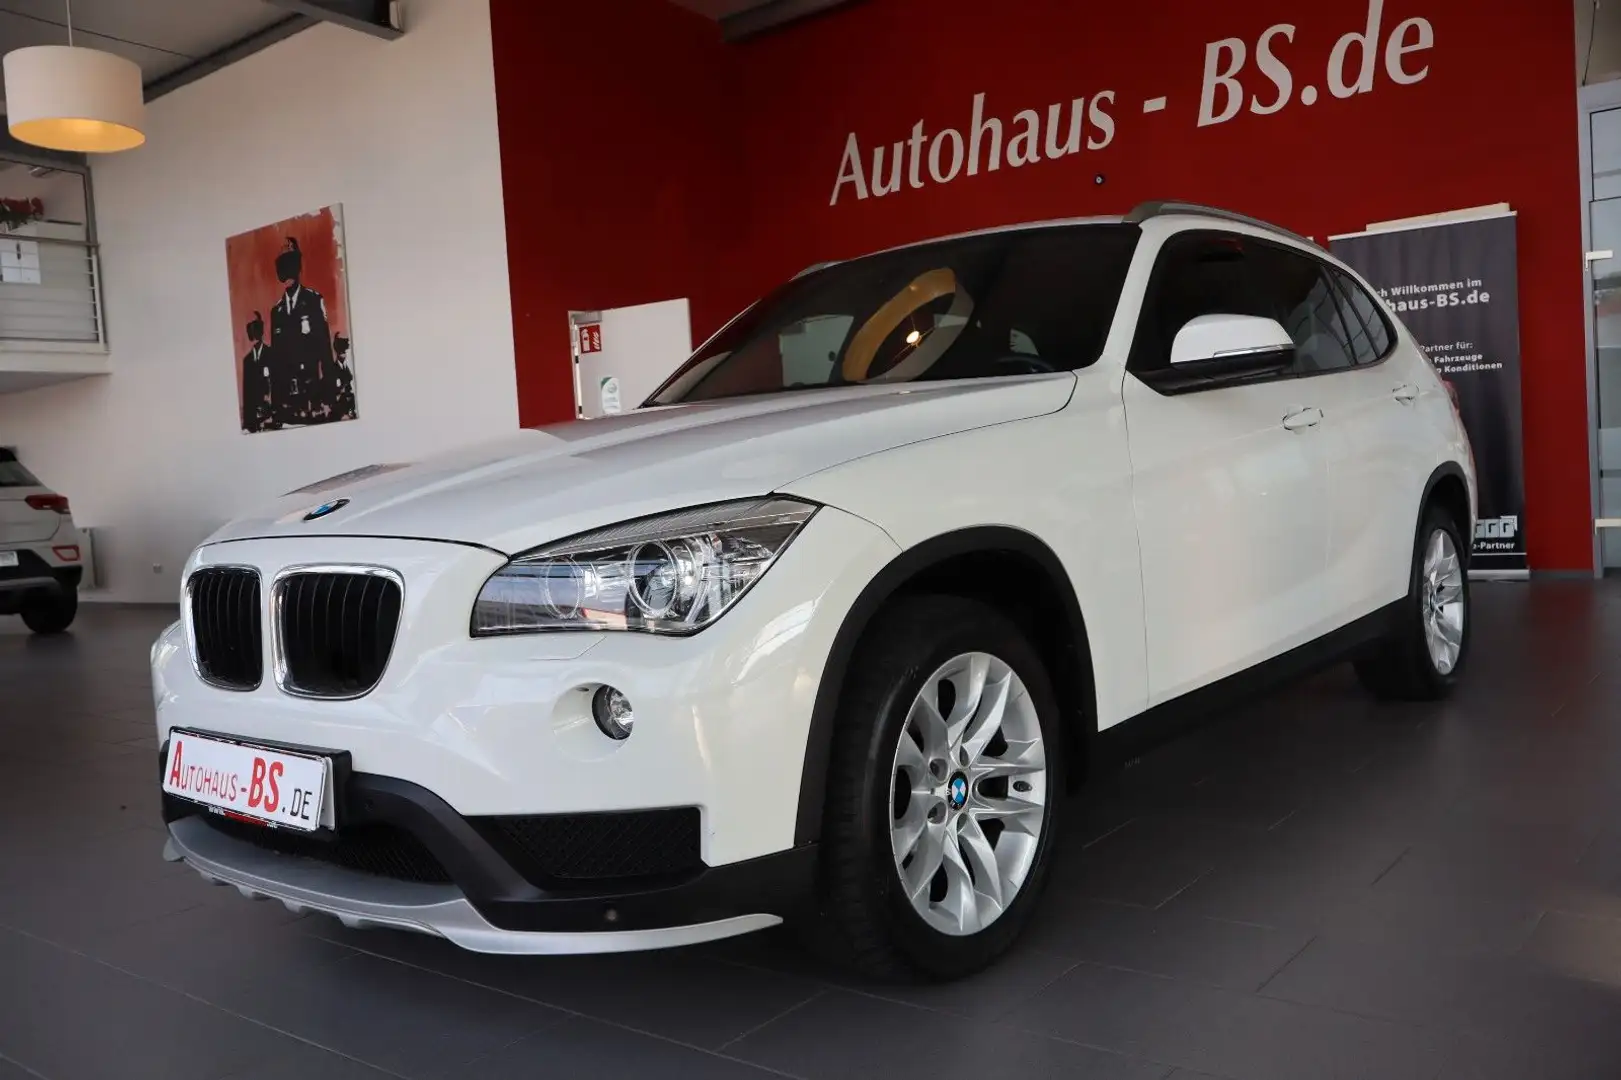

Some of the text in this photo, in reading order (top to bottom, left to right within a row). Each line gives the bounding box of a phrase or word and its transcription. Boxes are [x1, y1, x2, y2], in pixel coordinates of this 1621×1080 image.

[829, 90, 1116, 206] Autohaus
[1197, 0, 1435, 127] BS.de
[1391, 280, 1464, 296] Willkommen
[1467, 278, 1482, 287] im
[1387, 290, 1490, 312] haus-BS.de
[1456, 342, 1473, 350] für:
[1434, 353, 1483, 364] Fahrzeuge
[1444, 362, 1503, 373] Konditionen
